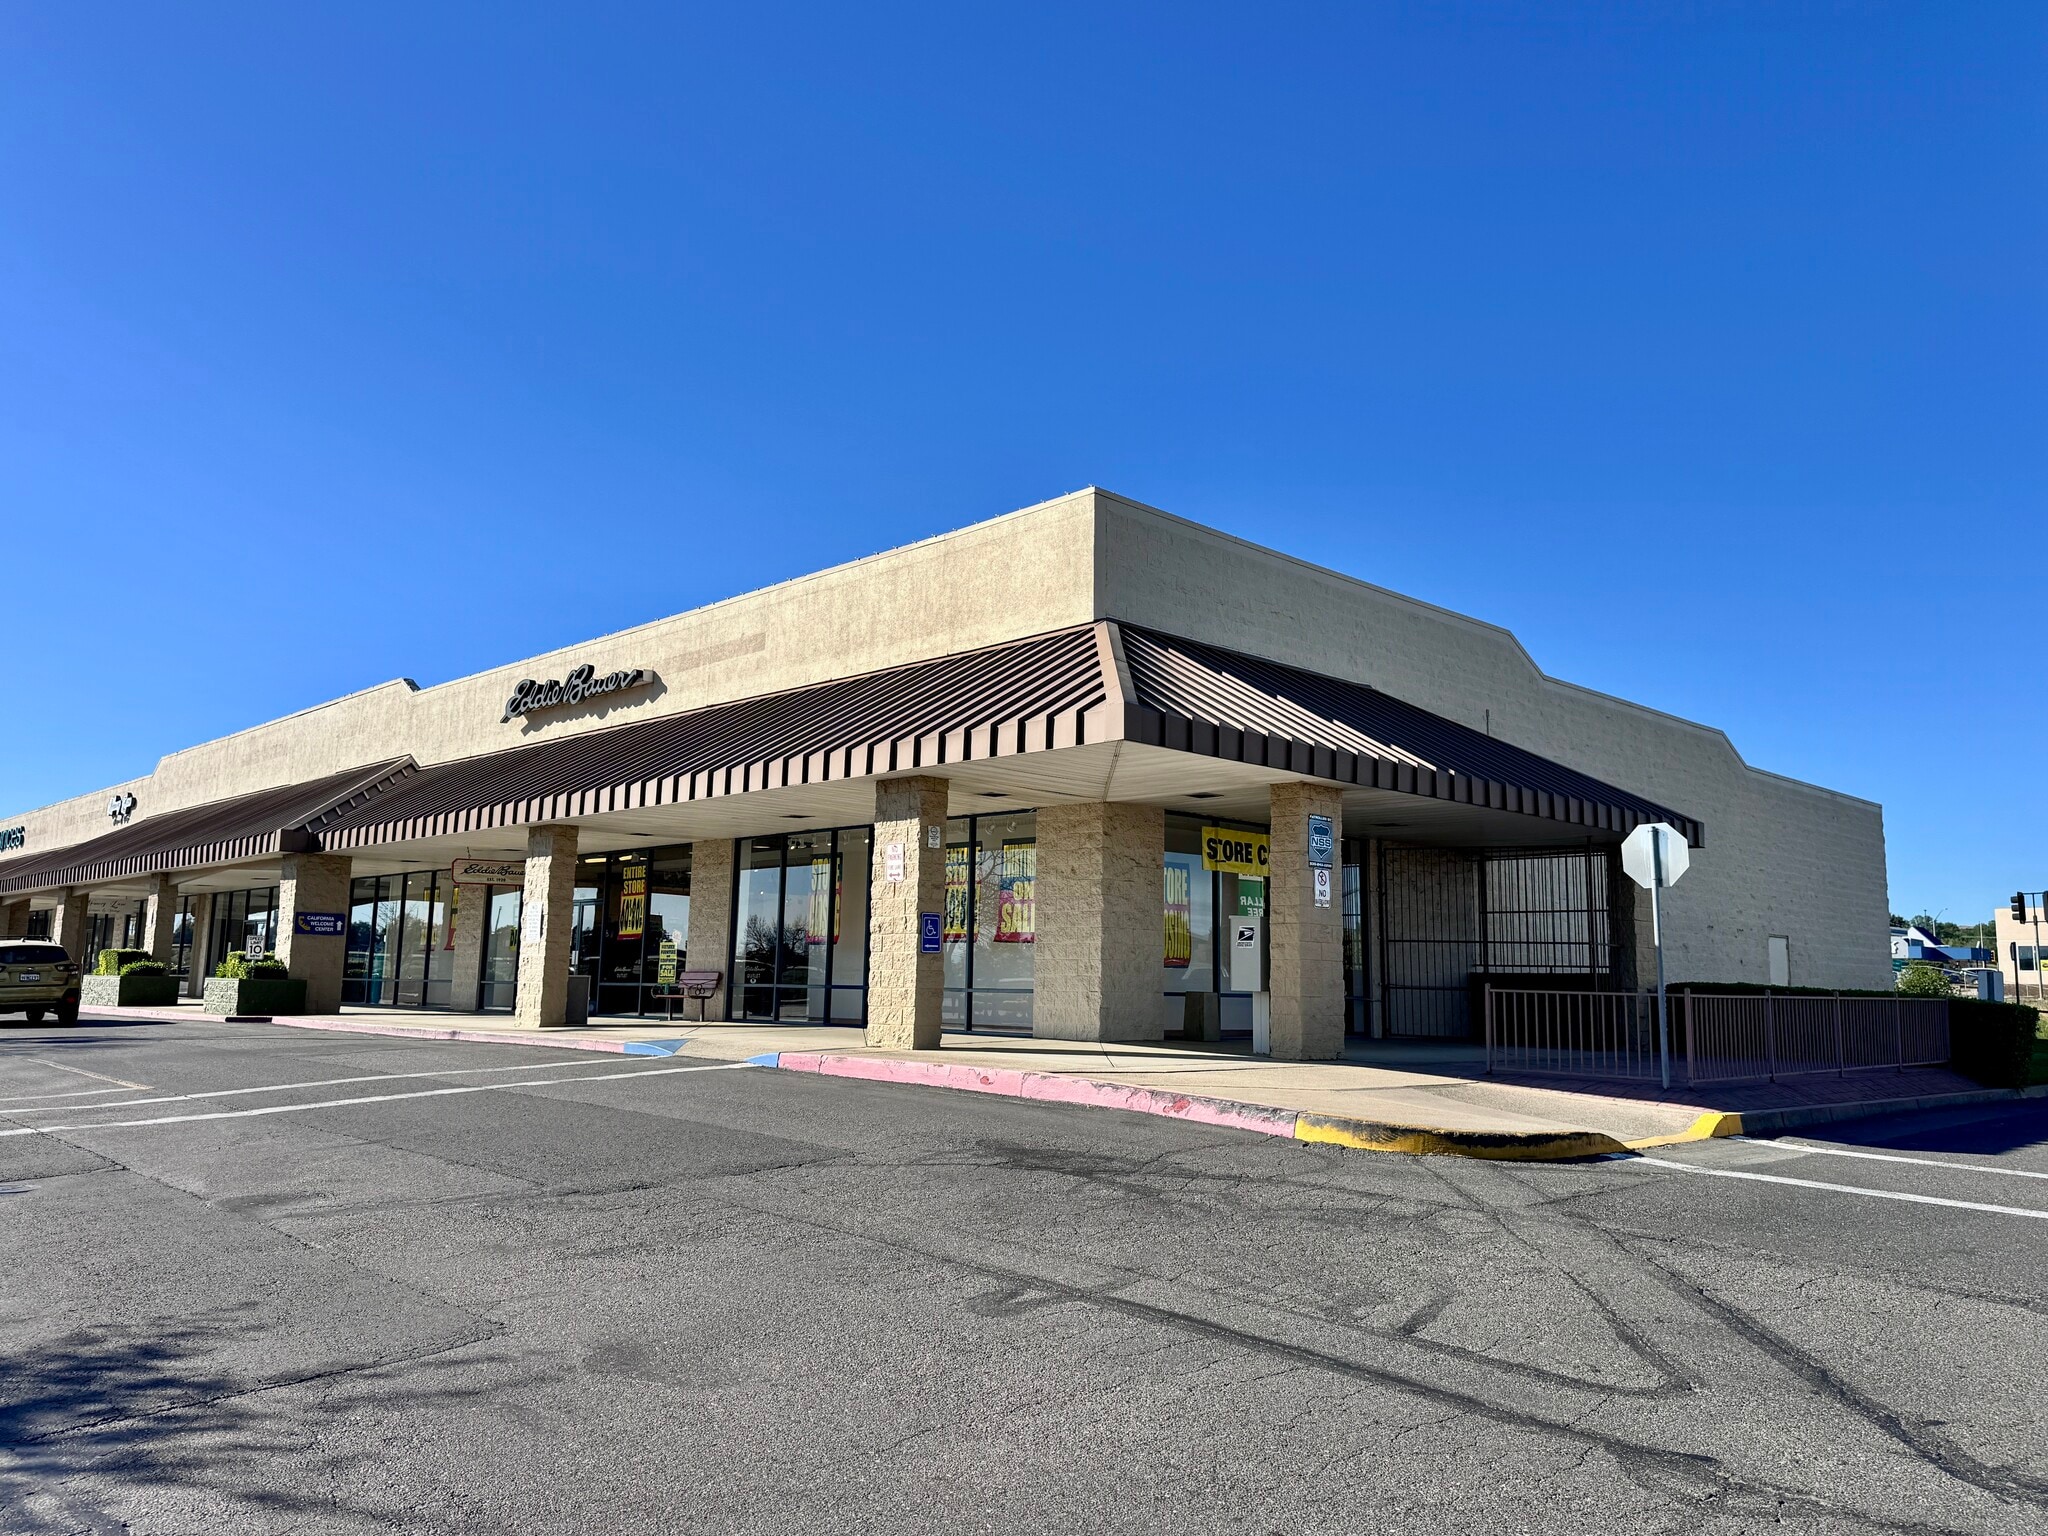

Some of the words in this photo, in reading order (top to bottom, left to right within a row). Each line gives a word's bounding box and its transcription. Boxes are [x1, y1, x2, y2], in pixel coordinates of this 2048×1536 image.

[500, 678, 565, 723] Eddie
[563, 664, 644, 705] Bauer
[1311, 837, 1331, 848] NSS
[1206, 838, 1253, 863] STORE
[1257, 844, 1270, 866] C
[497, 865, 525, 876] Baue
[623, 866, 646, 879] ENTIRE
[811, 857, 842, 891] STOE
[624, 880, 645, 894] STORE
[1013, 881, 1035, 901] ON
[1318, 889, 1327, 898] NO
[249, 945, 263, 955] 10
